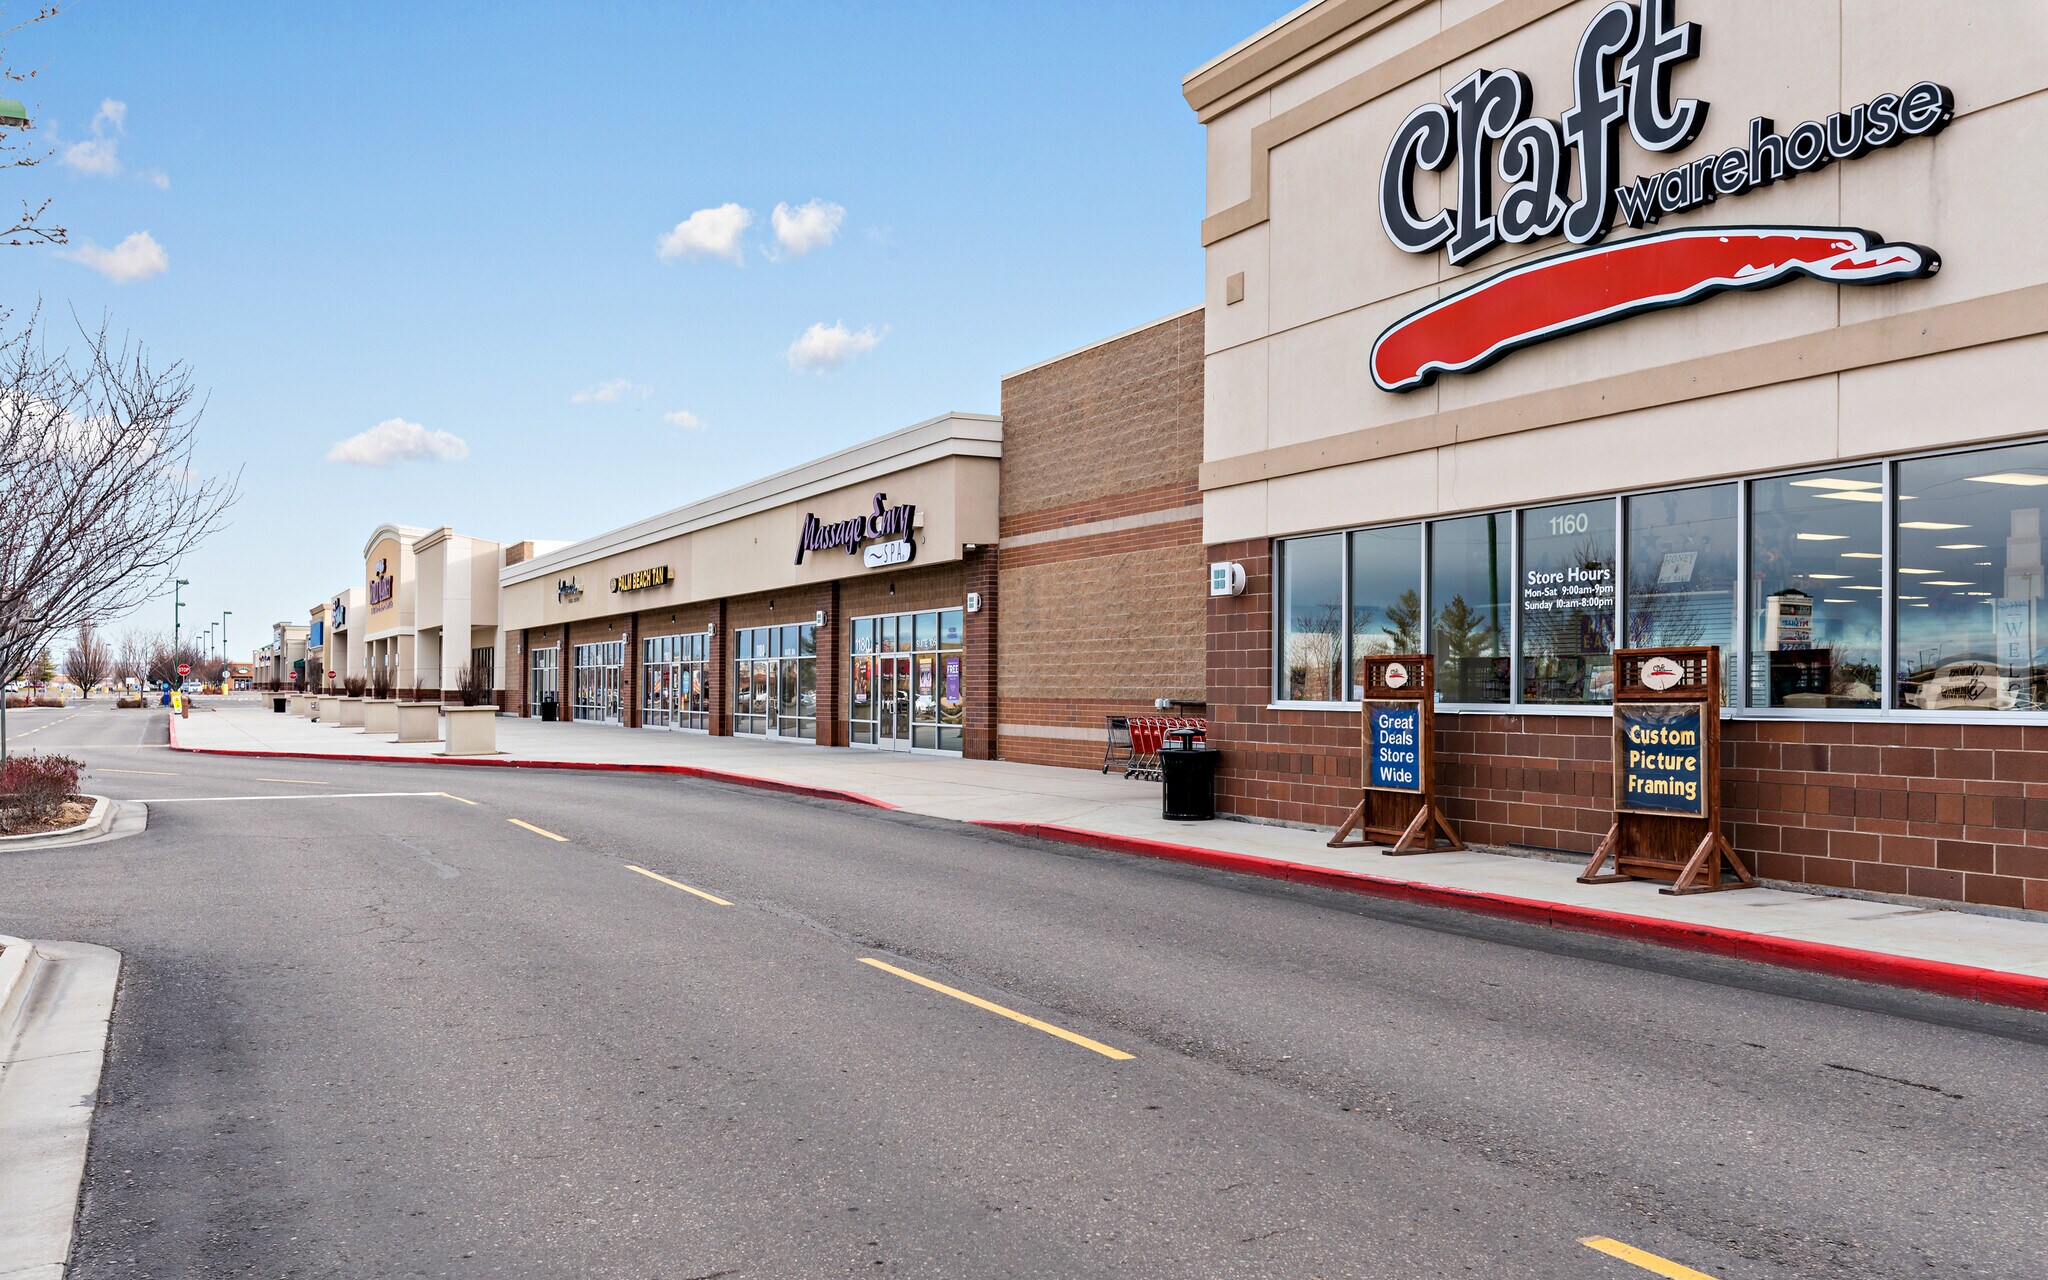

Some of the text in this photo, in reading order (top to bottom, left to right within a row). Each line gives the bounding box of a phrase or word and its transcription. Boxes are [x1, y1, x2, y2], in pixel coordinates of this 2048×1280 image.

[1614, 81, 1955, 228] warehouse
[794, 493, 916, 565] Massage Envy
[1550, 513, 1588, 535] 1160
[884, 543, 903, 563] SPA
[1664, 553, 1696, 565] HONEY
[618, 566, 666, 592] PALM BEACH TAN
[1528, 567, 1610, 585] Store Hours
[1525, 585, 1613, 598] Mon-Sat 9:00am-9pm
[1525, 600, 1553, 611] Sunday
[855, 637, 870, 652] 1180
[947, 664, 959, 674] FREE
[1379, 715, 1414, 729] Great
[1380, 731, 1413, 745] Deals
[1631, 725, 1695, 745] Custom
[1380, 748, 1414, 763] Store
[1630, 750, 1697, 771] Picture
[1380, 767, 1412, 782] Wide
[1628, 775, 1697, 801] Framing
